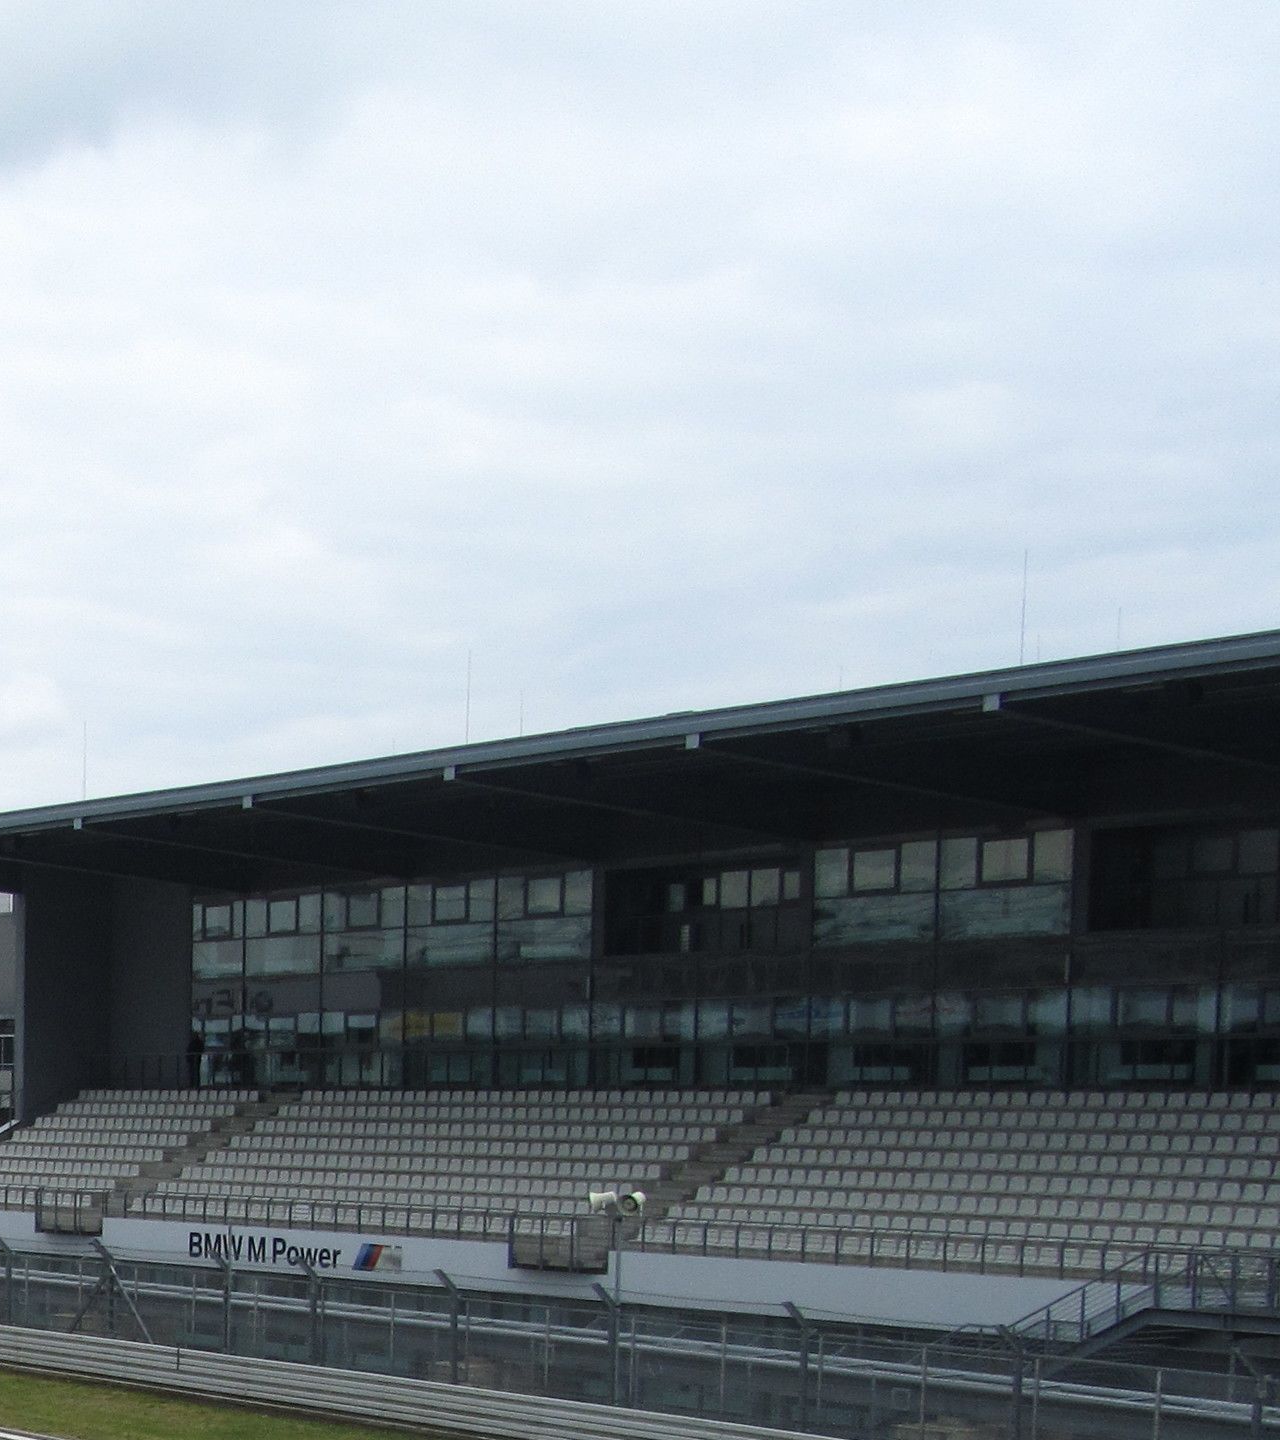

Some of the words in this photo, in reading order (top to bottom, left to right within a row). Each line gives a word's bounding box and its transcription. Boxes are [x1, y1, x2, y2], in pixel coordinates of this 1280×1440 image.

[189, 1231, 243, 1260] BMW
[247, 1236, 267, 1263] M
[272, 1238, 342, 1269] Power
